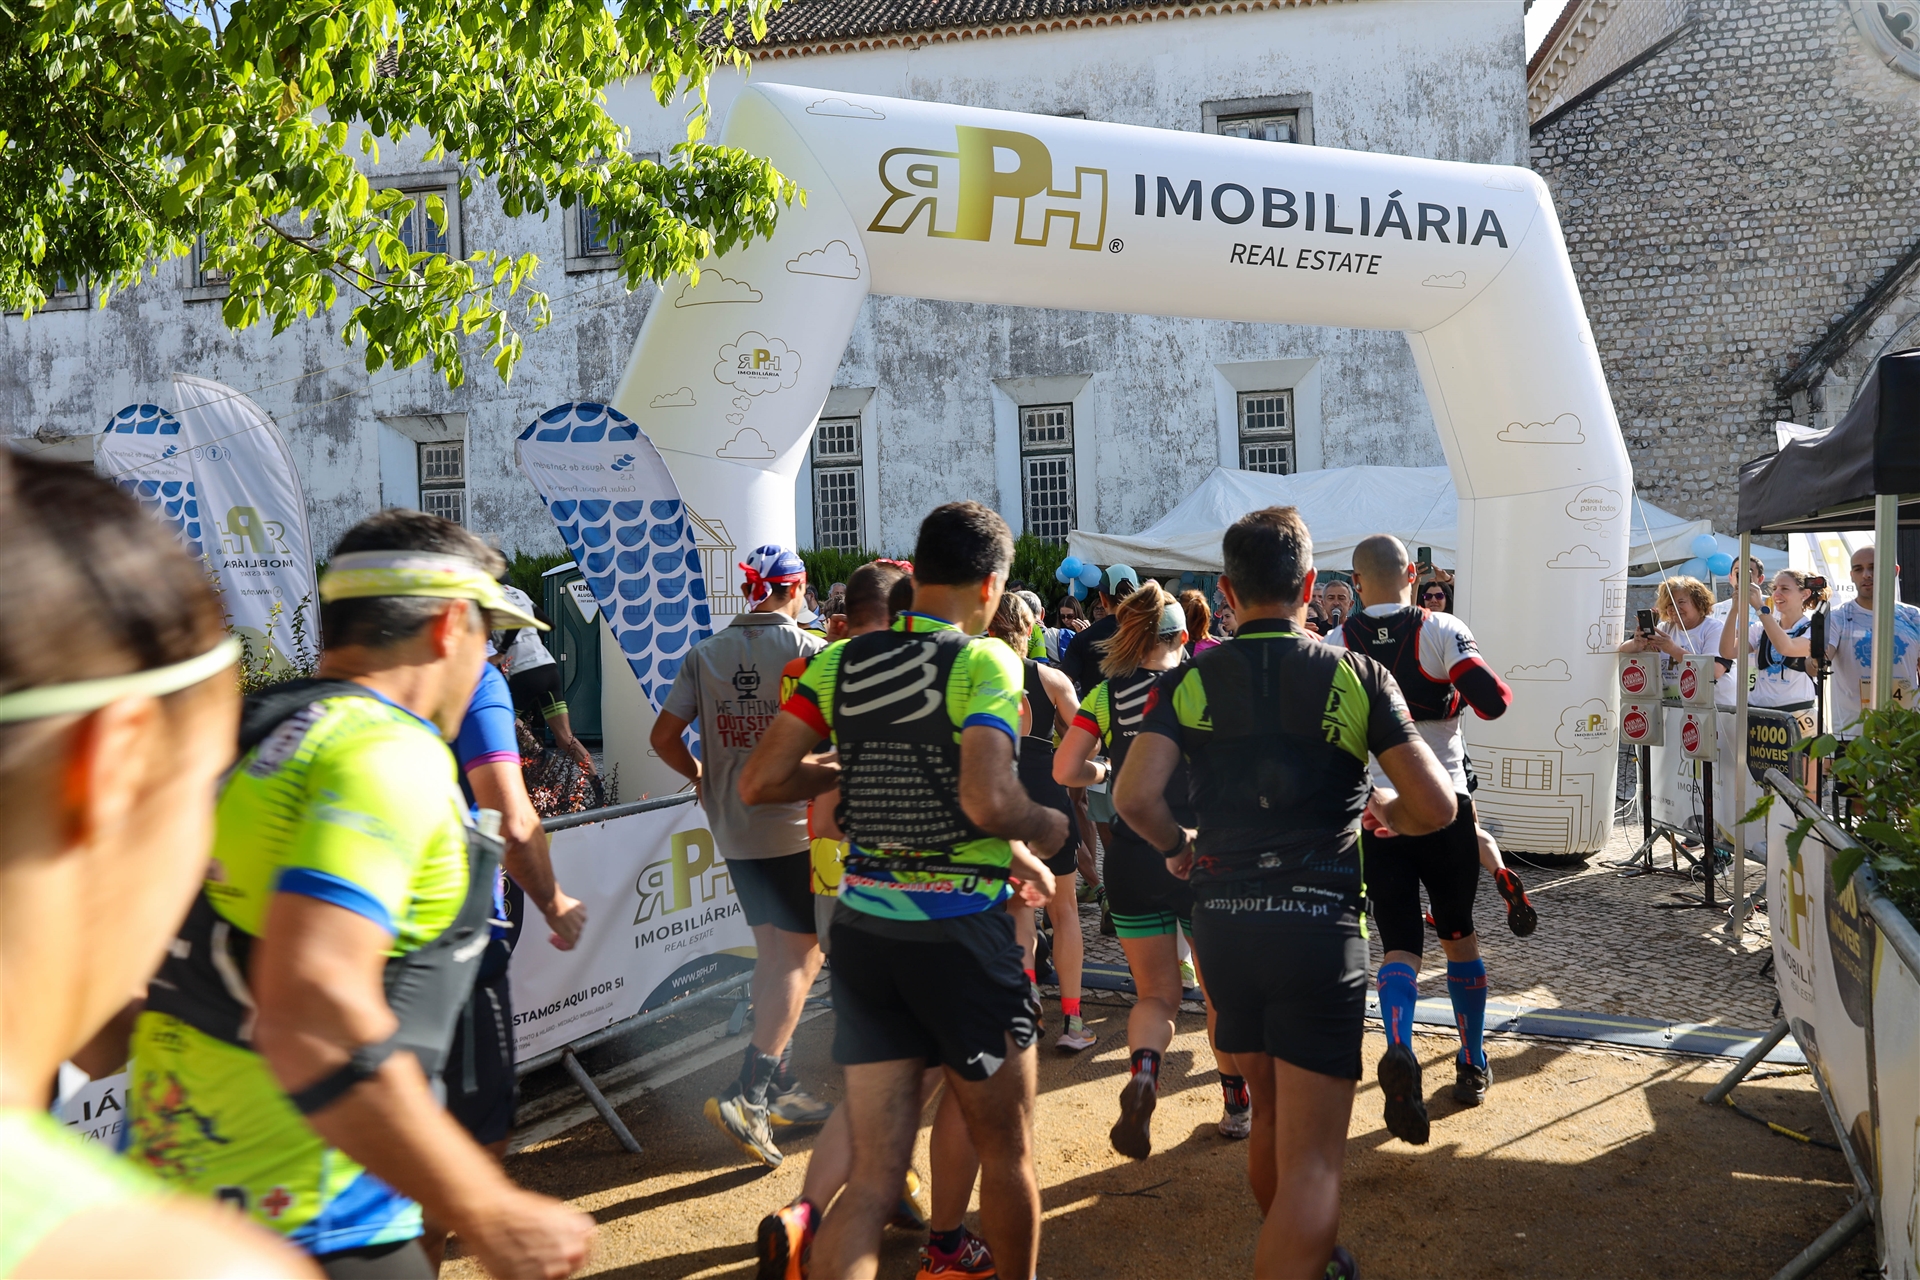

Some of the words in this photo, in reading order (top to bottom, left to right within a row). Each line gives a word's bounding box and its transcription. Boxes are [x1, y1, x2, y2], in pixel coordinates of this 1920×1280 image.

[1134, 173, 1509, 249] IMOBILIÁRIA
[1229, 242, 1289, 268] REAL
[1296, 248, 1382, 276] ESTATE
[737, 370, 780, 378] IMOBILIÁRIA
[1580, 505, 1597, 513] para
[1599, 504, 1616, 512] todos
[572, 584, 590, 592] VEN
[716, 699, 733, 716] WE
[718, 730, 753, 749] THE
[1749, 725, 1788, 745] +1000
[1749, 744, 1789, 762] IMÓVEIS
[634, 902, 742, 949] IMOBILIÁRIA
[664, 939, 688, 954] REAL
[689, 927, 715, 945] ESTATE
[671, 961, 719, 988] WWW.RPH.PT
[562, 989, 588, 1010] AQUI
[590, 981, 613, 998] POR
[614, 976, 625, 989] SI
[518, 1033, 535, 1045] PINTO
